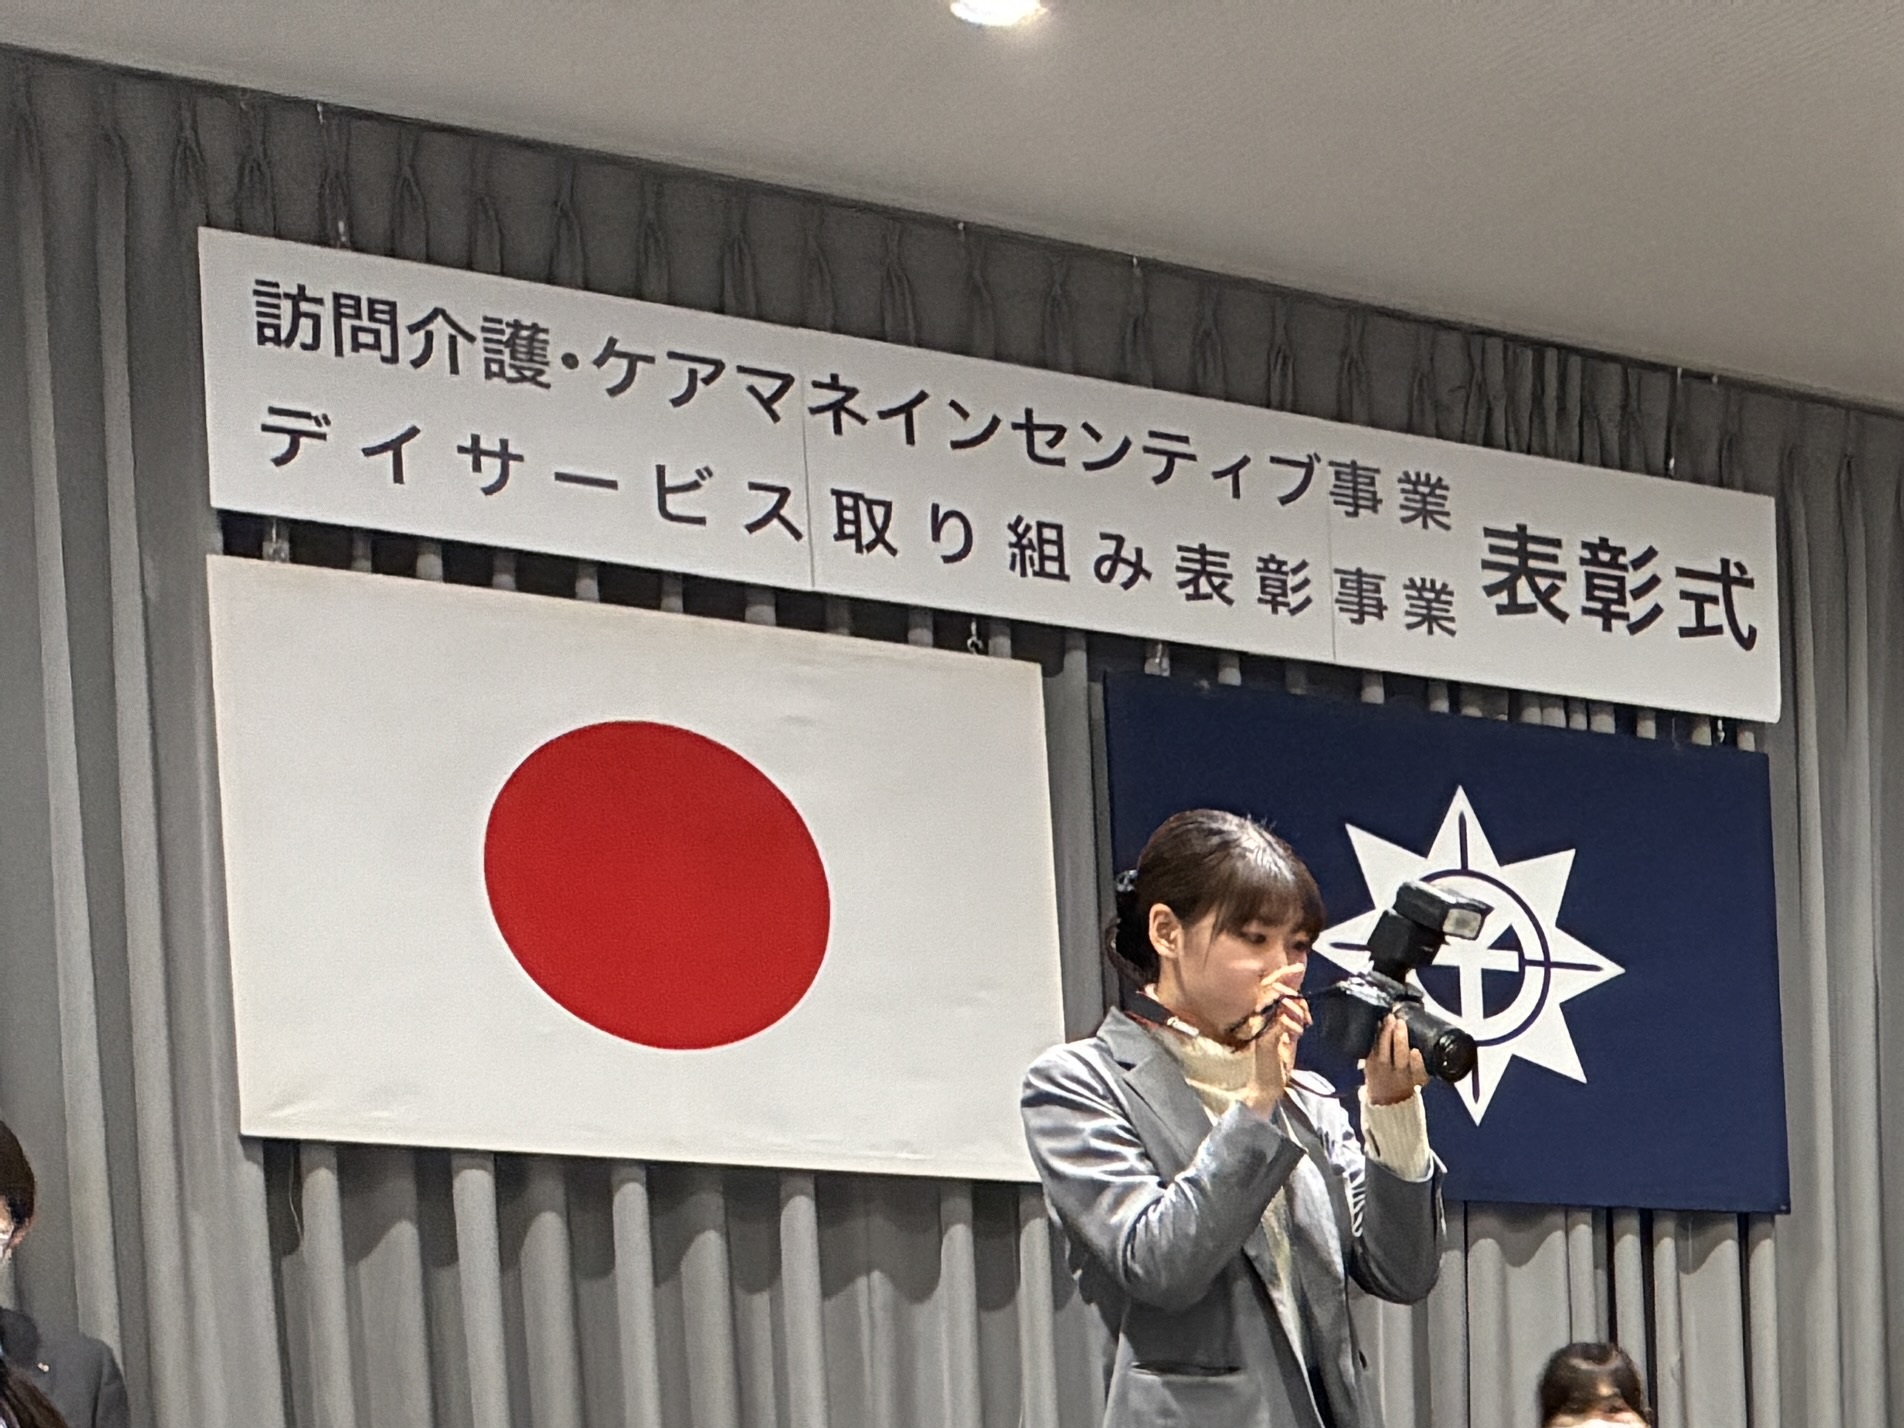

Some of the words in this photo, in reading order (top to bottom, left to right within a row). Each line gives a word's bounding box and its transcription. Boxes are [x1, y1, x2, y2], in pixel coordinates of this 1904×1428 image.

[252, 277, 1452, 532] 訪問介護・ケアマネインセンティブ事業
[259, 405, 1460, 638] デイサービス取り組み表彰事業
[1479, 522, 1760, 653] 表彰式
